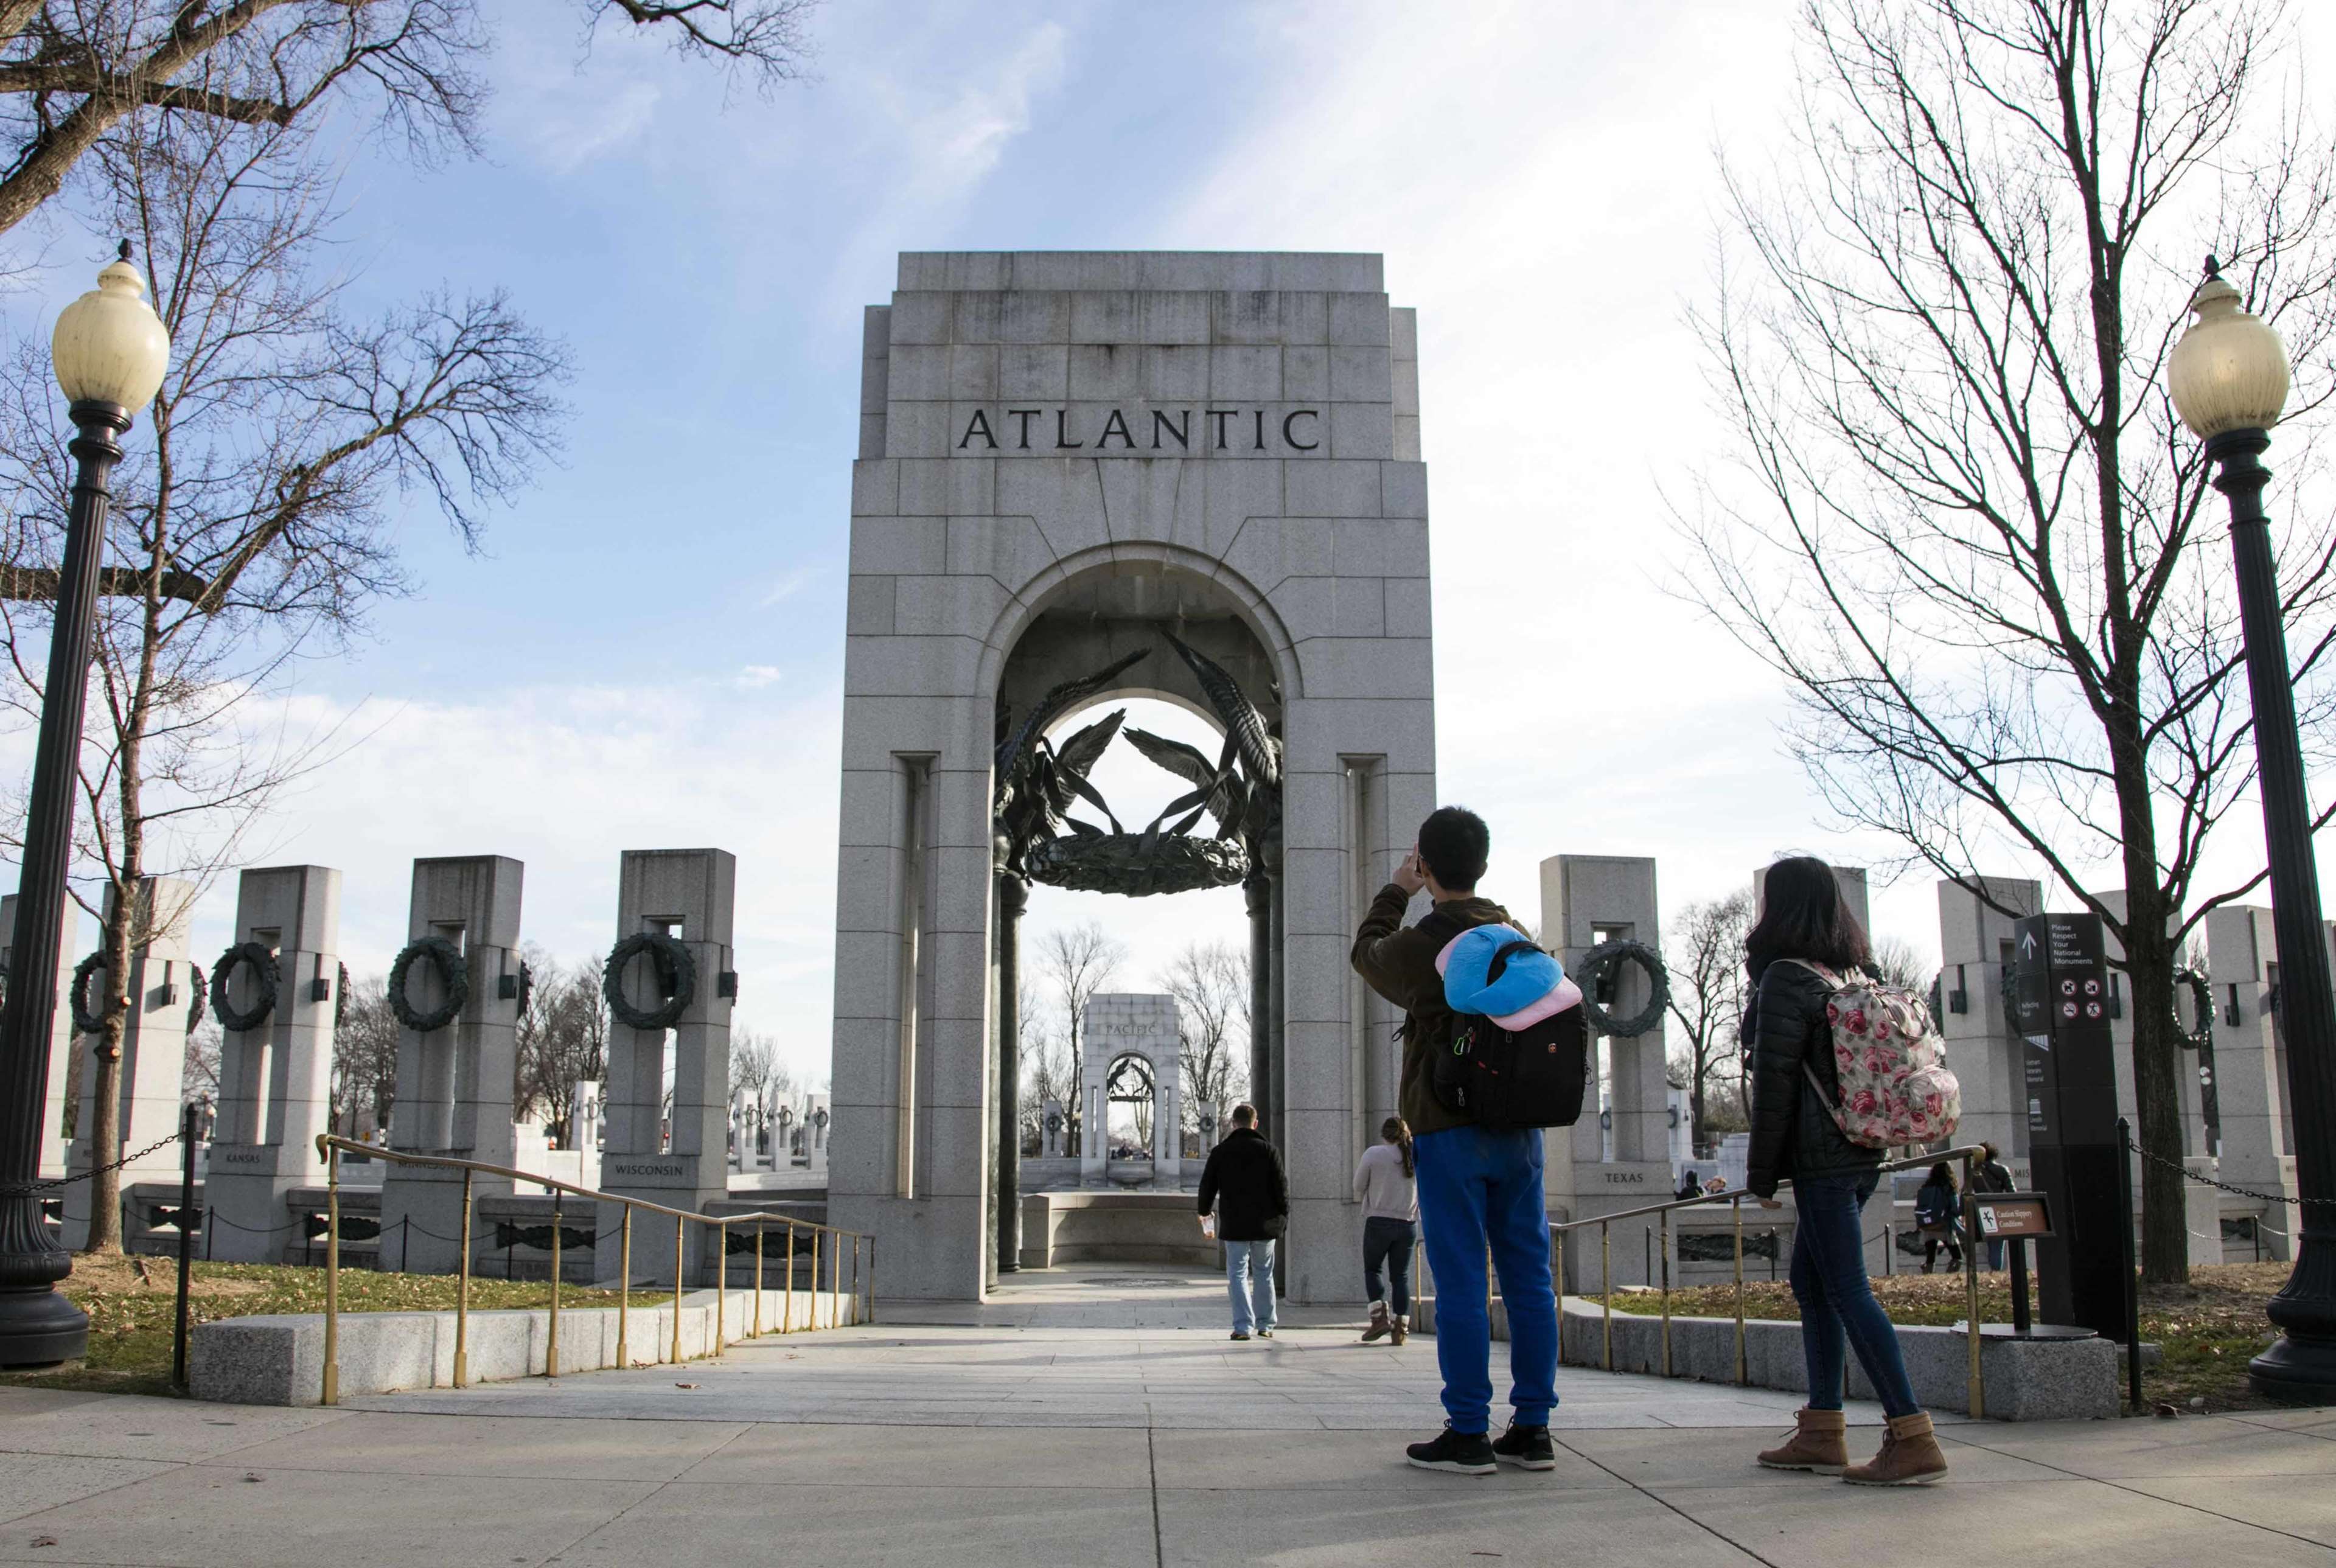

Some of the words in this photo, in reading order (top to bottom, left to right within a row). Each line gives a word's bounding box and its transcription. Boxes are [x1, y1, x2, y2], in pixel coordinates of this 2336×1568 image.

[957, 408, 1320, 450] ATLANTIC
[1106, 1025, 1156, 1034] PACIFIC
[226, 1154, 260, 1163] KANSAS
[615, 1165, 683, 1176] WISCONSIN
[1605, 1173, 1643, 1183] TEXAS
